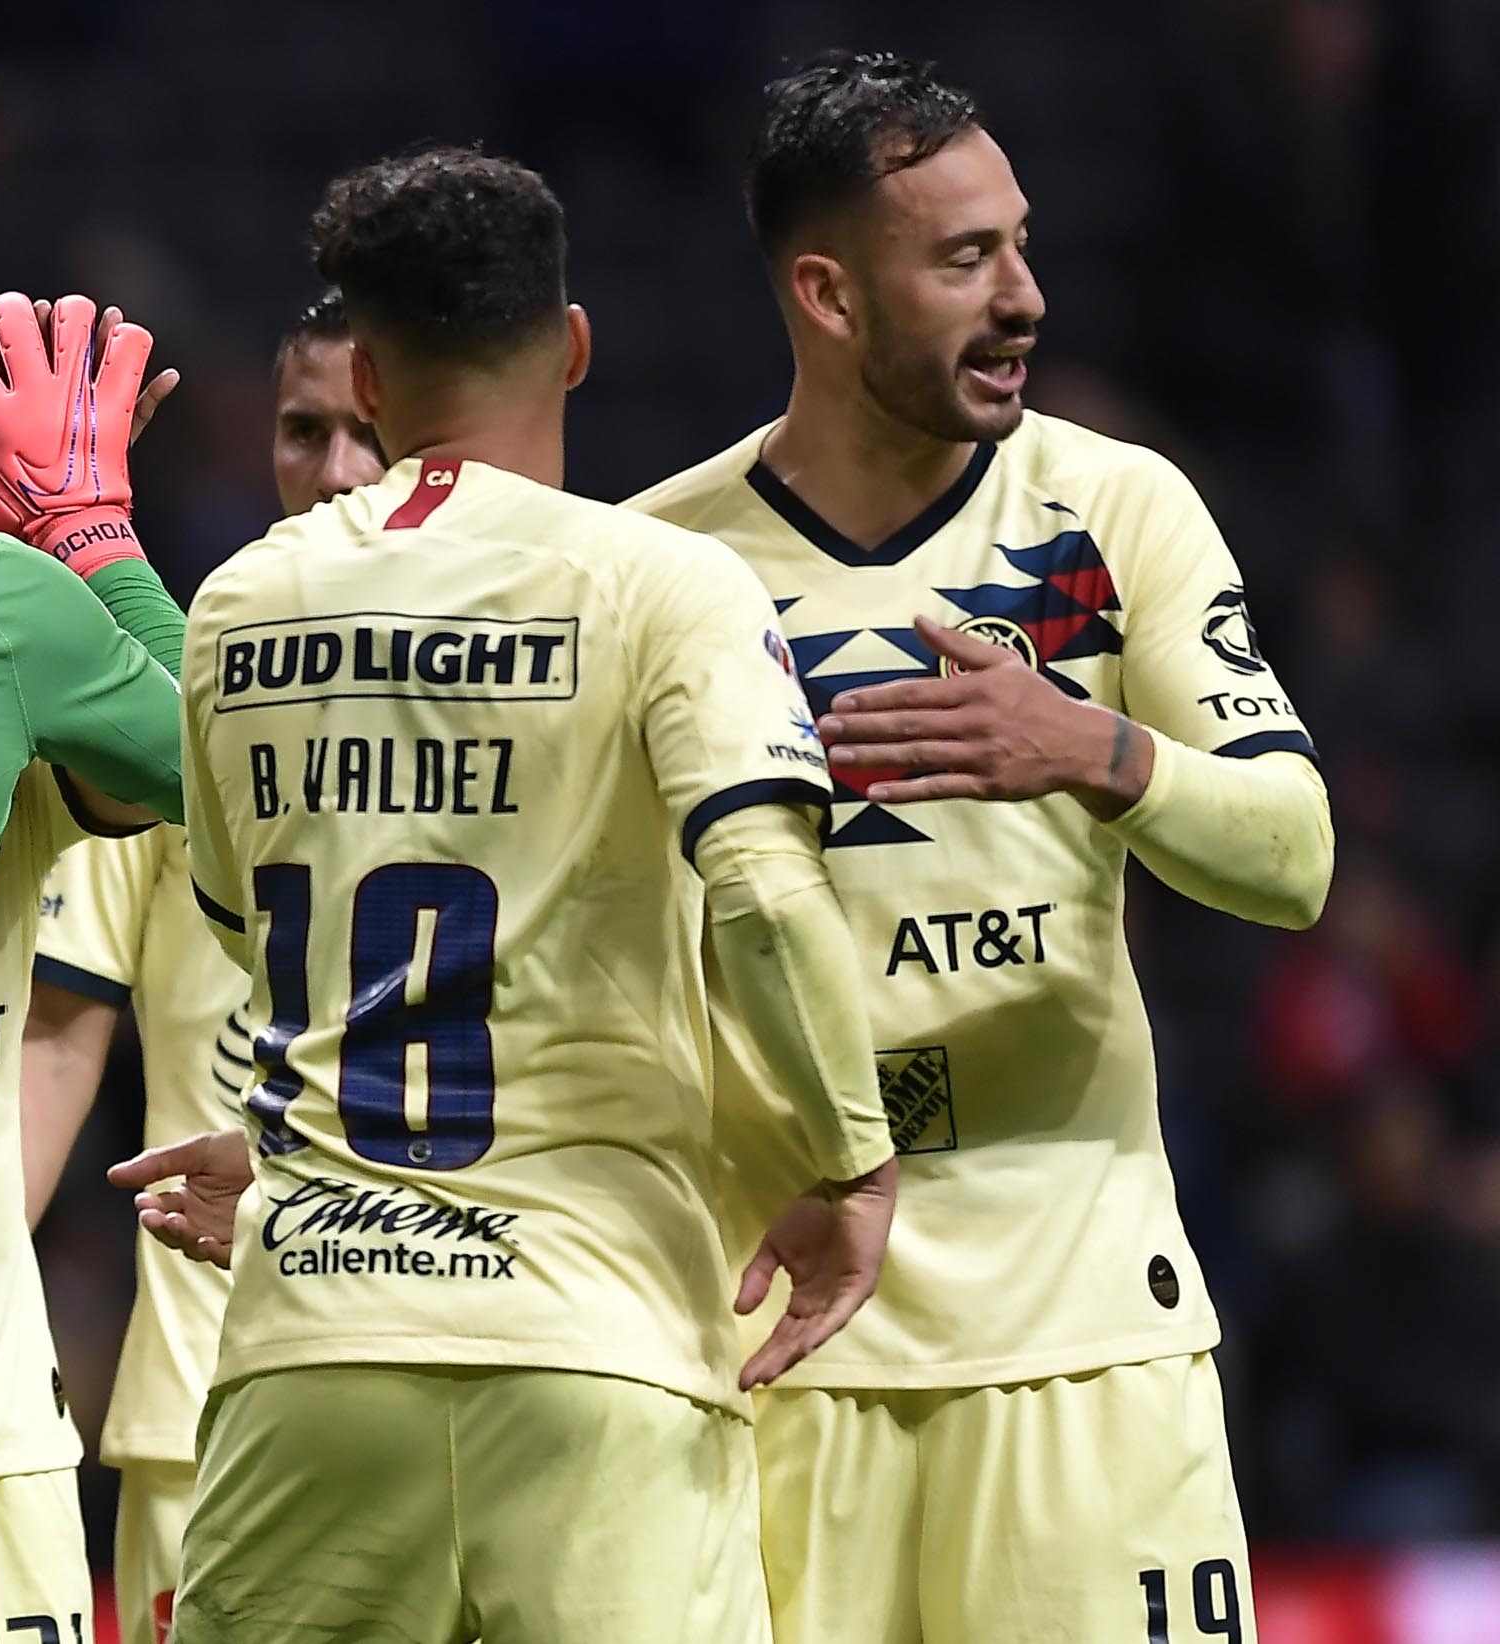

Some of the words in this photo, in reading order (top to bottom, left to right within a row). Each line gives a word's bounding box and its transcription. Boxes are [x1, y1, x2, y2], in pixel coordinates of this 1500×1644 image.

[53, 523, 135, 563] OCHOA
[223, 632, 343, 697] BUD
[1197, 692, 1298, 721] TOT
[886, 904, 1053, 975] AT&T
[247, 862, 499, 1171] 18
[262, 1178, 519, 1250] Caliente
[280, 1240, 516, 1279] caliente.mx
[1139, 1558, 1241, 1644] 19
